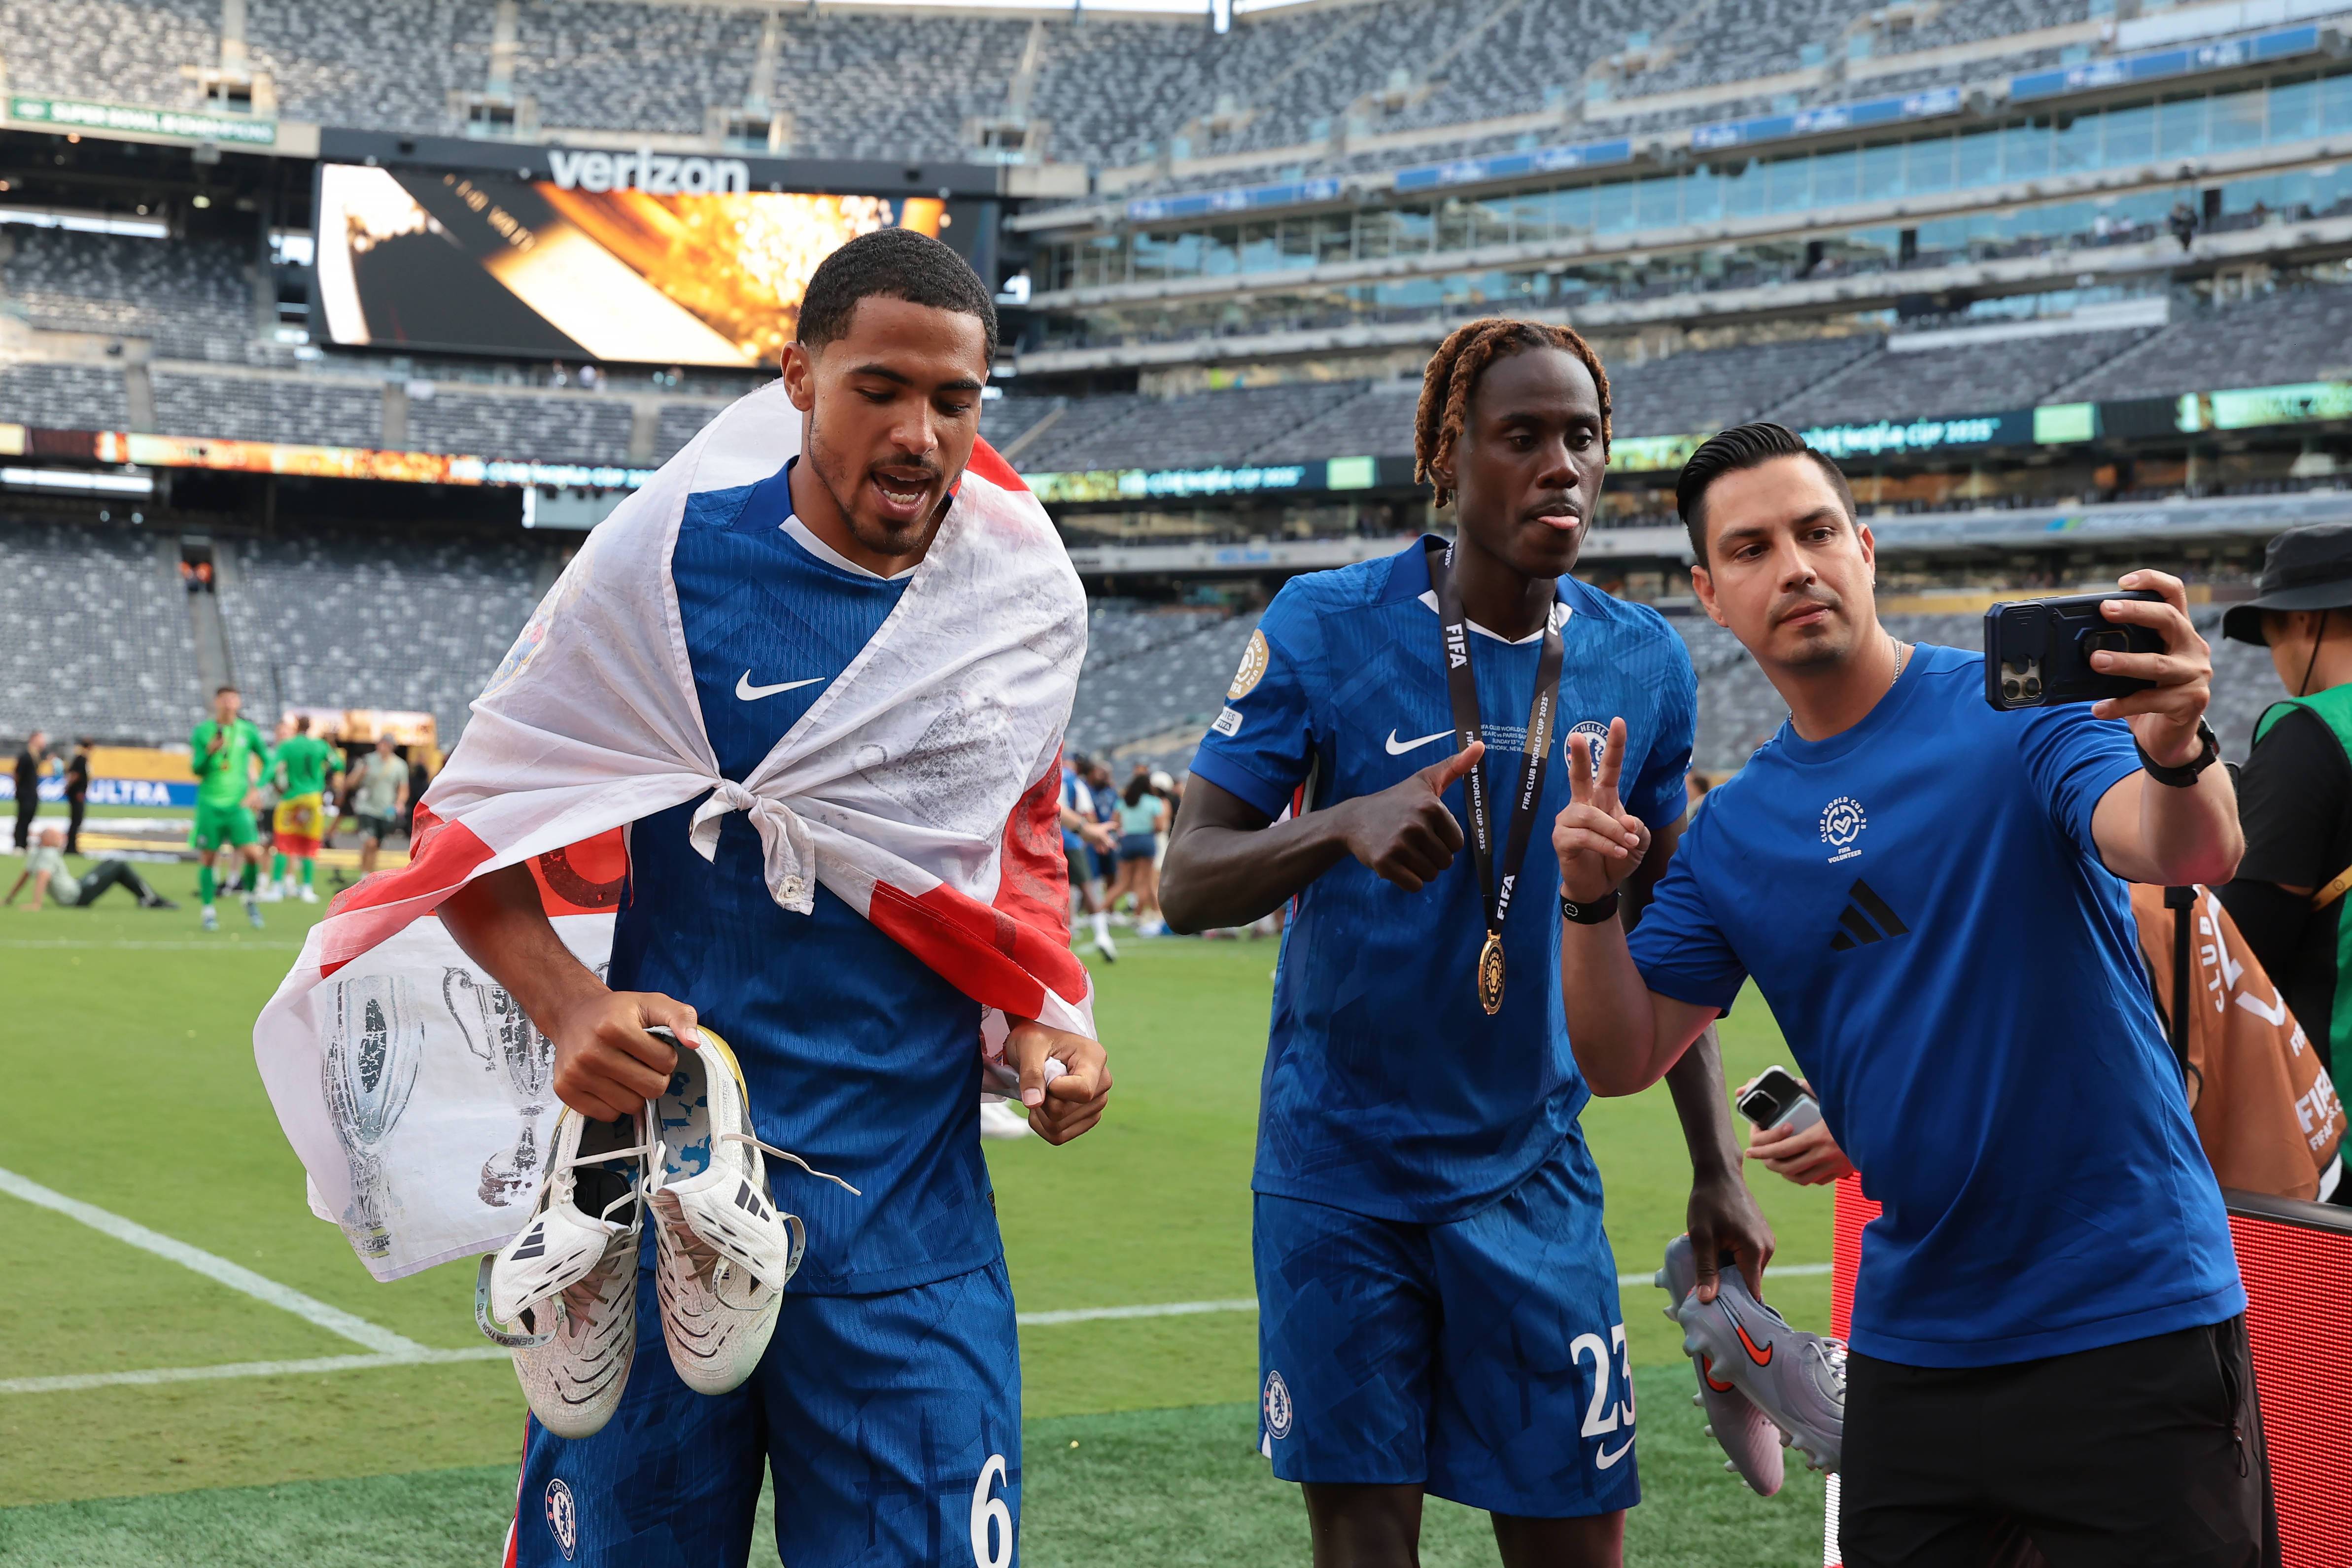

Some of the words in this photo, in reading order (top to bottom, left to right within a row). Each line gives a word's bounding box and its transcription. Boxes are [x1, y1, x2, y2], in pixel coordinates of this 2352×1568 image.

[547, 146, 750, 197] verizon
[1254, 638, 1263, 653] CUP
[1446, 623, 1467, 669] FIFA
[1256, 656, 1263, 667] 25
[1230, 681, 1243, 695] IFA
[1246, 669, 1259, 686] USA
[1531, 736, 1542, 767] WORLD
[1472, 774, 1482, 807] WORLD
[1526, 768, 1536, 790] CLUB
[86, 778, 171, 806] ULTRA
[1522, 792, 1532, 810] FIFA
[1822, 796, 1848, 815] WORLD
[1850, 799, 1864, 814] CUP
[1819, 819, 1828, 843] CLUB
[1861, 818, 1867, 829] 25
[1828, 849, 1862, 864] VOLUNTEER
[1497, 875, 1516, 921] FIFA
[481, 1322, 535, 1346] GENERATION
[1569, 1323, 1636, 1438] 23
[552, 1483, 572, 1508] CHELSEA
[970, 1454, 1013, 1568] 6
